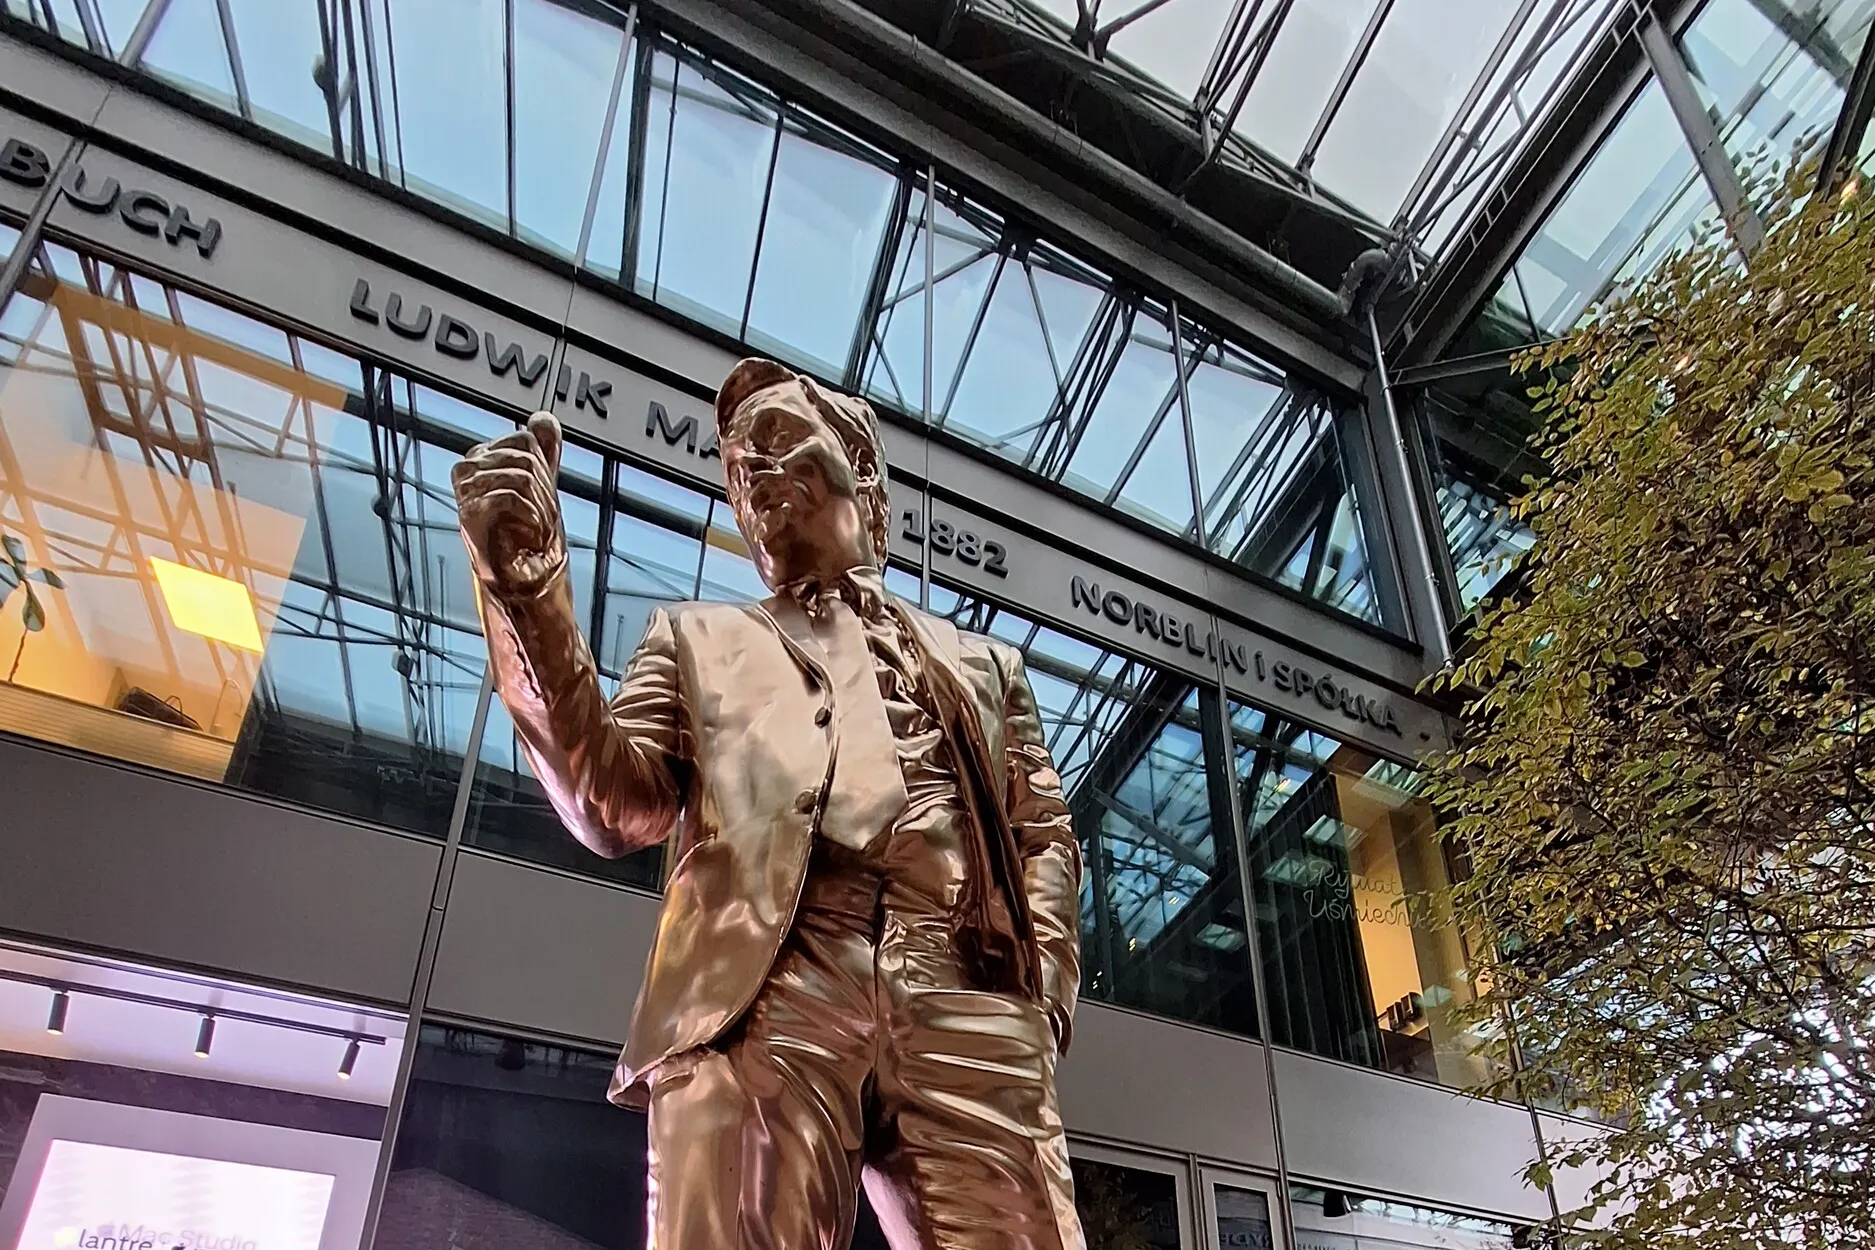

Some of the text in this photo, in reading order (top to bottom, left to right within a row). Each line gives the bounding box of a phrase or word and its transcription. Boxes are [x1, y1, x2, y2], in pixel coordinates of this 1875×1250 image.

[0, 138, 222, 258] BUCH
[350, 277, 612, 419] LUDWIK
[902, 508, 1009, 579] 1882
[1070, 574, 1248, 674] NORBLIN
[1273, 660, 1402, 738] SPÓŁKA
